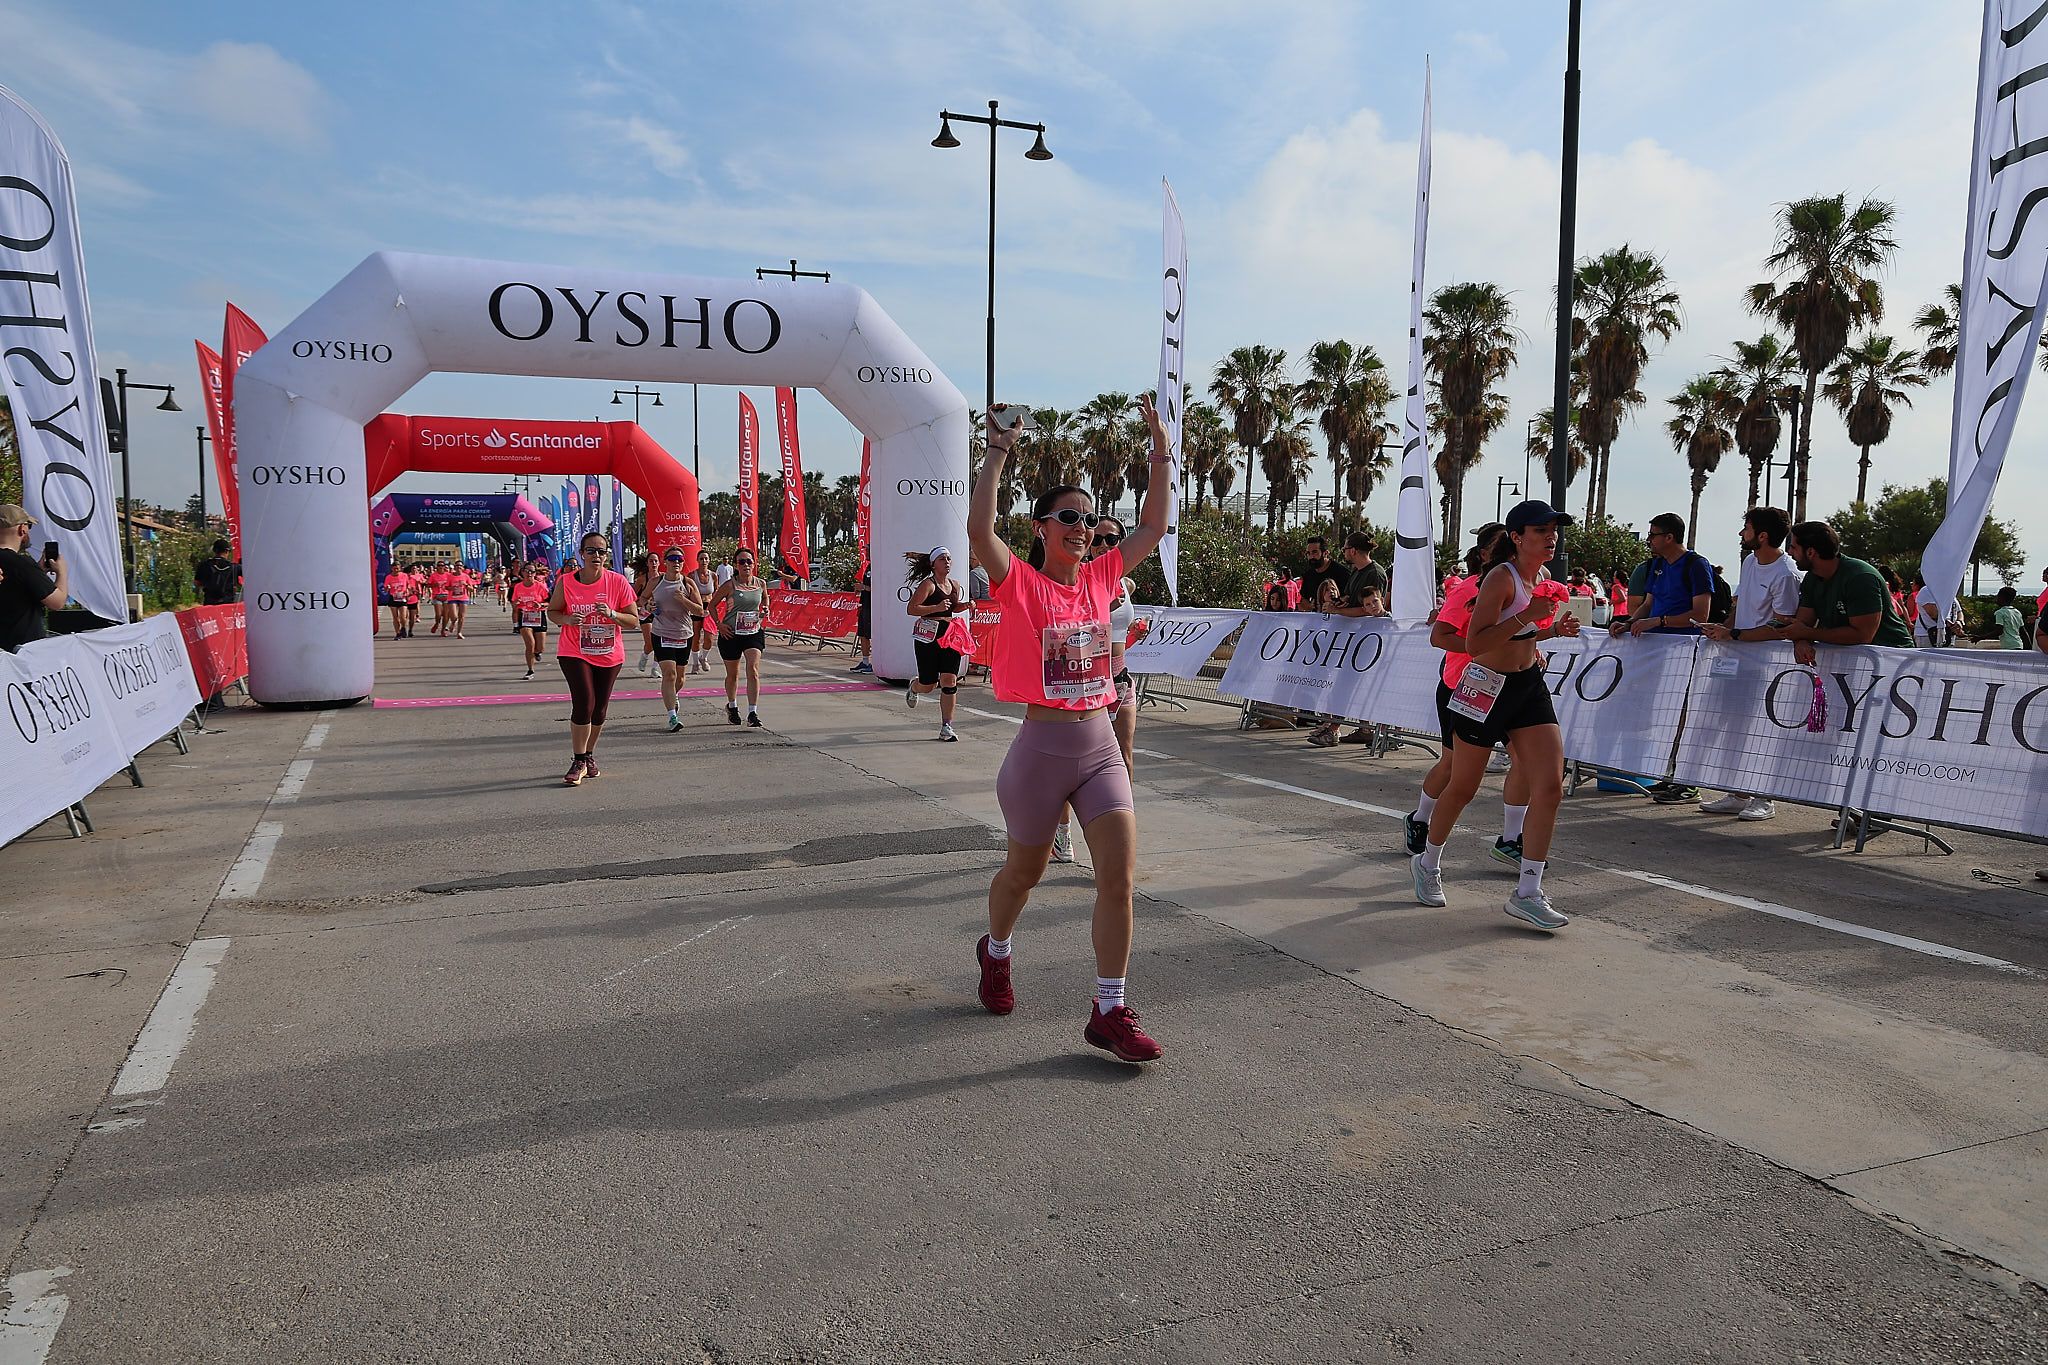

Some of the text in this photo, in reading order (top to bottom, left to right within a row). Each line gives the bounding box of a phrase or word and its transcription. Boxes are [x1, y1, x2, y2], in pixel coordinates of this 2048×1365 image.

[488, 281, 782, 355] OYSHO
[292, 340, 393, 364] OYSHO
[857, 366, 932, 384] OYSHO
[420, 429, 602, 450] Sports Santander
[480, 454, 541, 463] sportssantander.es
[252, 465, 346, 486] OYSHO
[897, 479, 965, 496] OYSHO
[665, 511, 690, 521] Sports
[257, 591, 350, 611] OYSHO
[1140, 619, 1212, 646] YSHO
[1260, 627, 1383, 673] OYSHO
[103, 643, 158, 699] OYSHO
[1068, 658, 1093, 671] 016
[1276, 673, 1334, 690] WWW.OYSHO.COM
[1462, 685, 1479, 698] 016
[7, 666, 91, 743] OYSHO
[1830, 753, 1976, 782] WWW.OYSHO.COM
